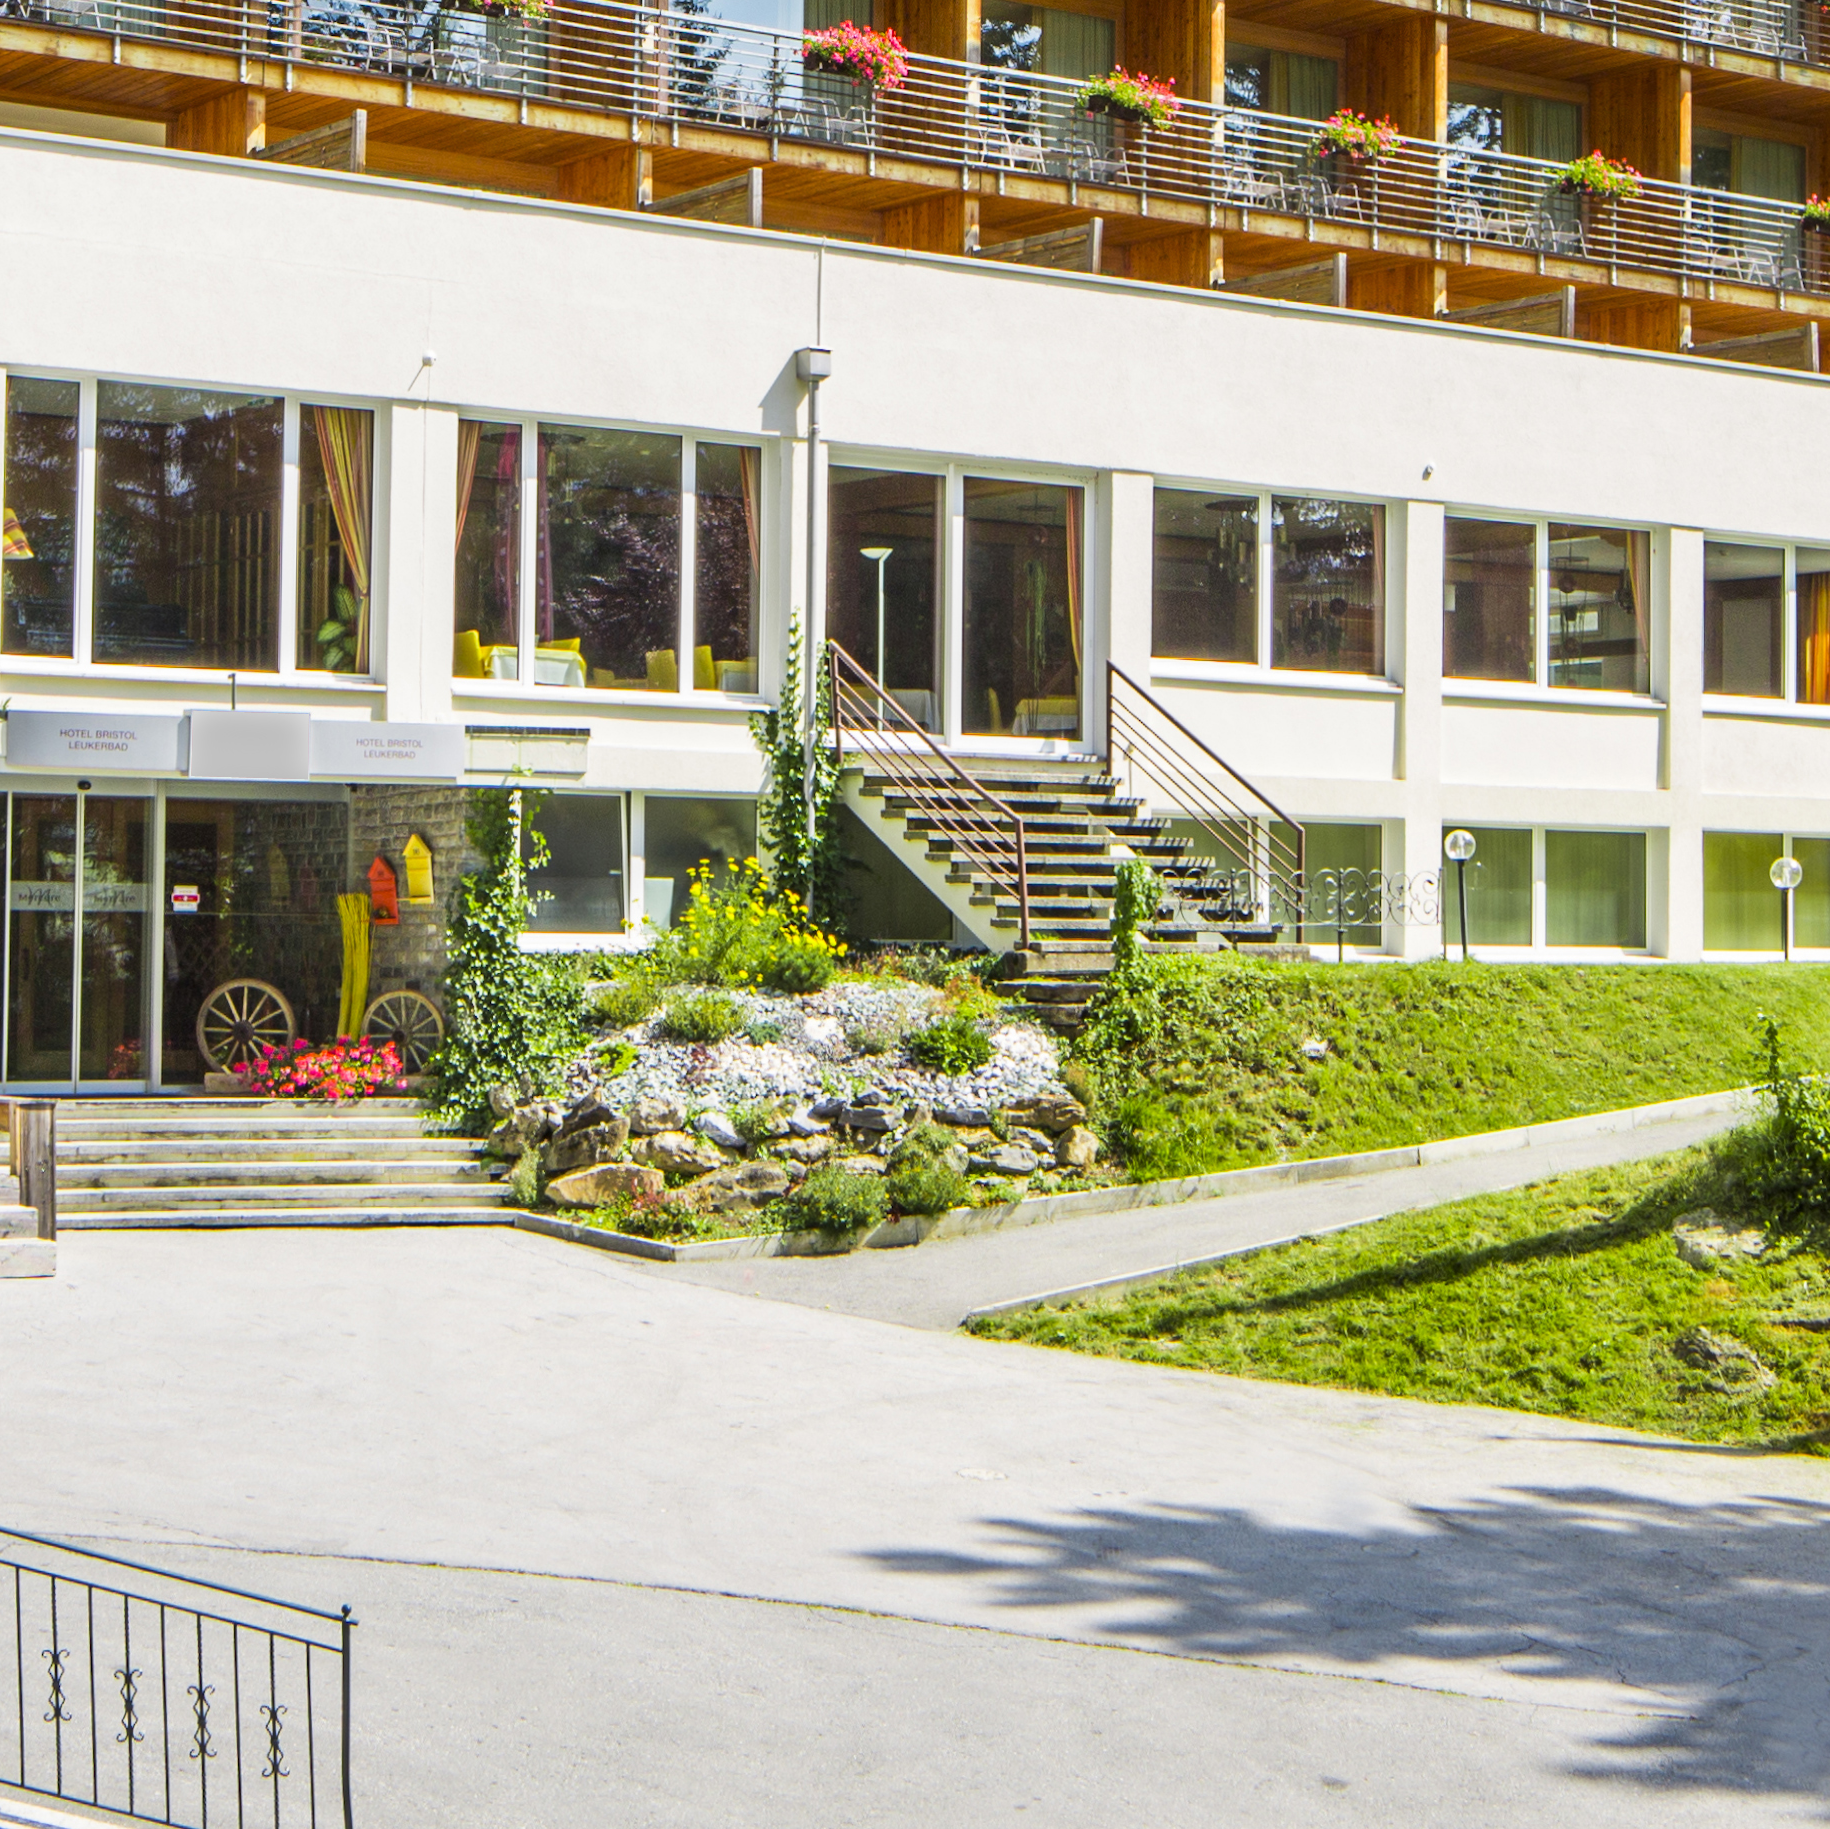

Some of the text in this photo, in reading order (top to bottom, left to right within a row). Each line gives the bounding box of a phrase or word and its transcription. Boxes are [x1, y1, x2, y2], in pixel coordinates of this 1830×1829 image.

[59, 729, 138, 740] HOTEL BRISTOL
[68, 740, 128, 751] LEUKERBAD
[356, 738, 423, 748] HOTEL BRISTOL
[363, 750, 416, 759] LEUKERBAD
